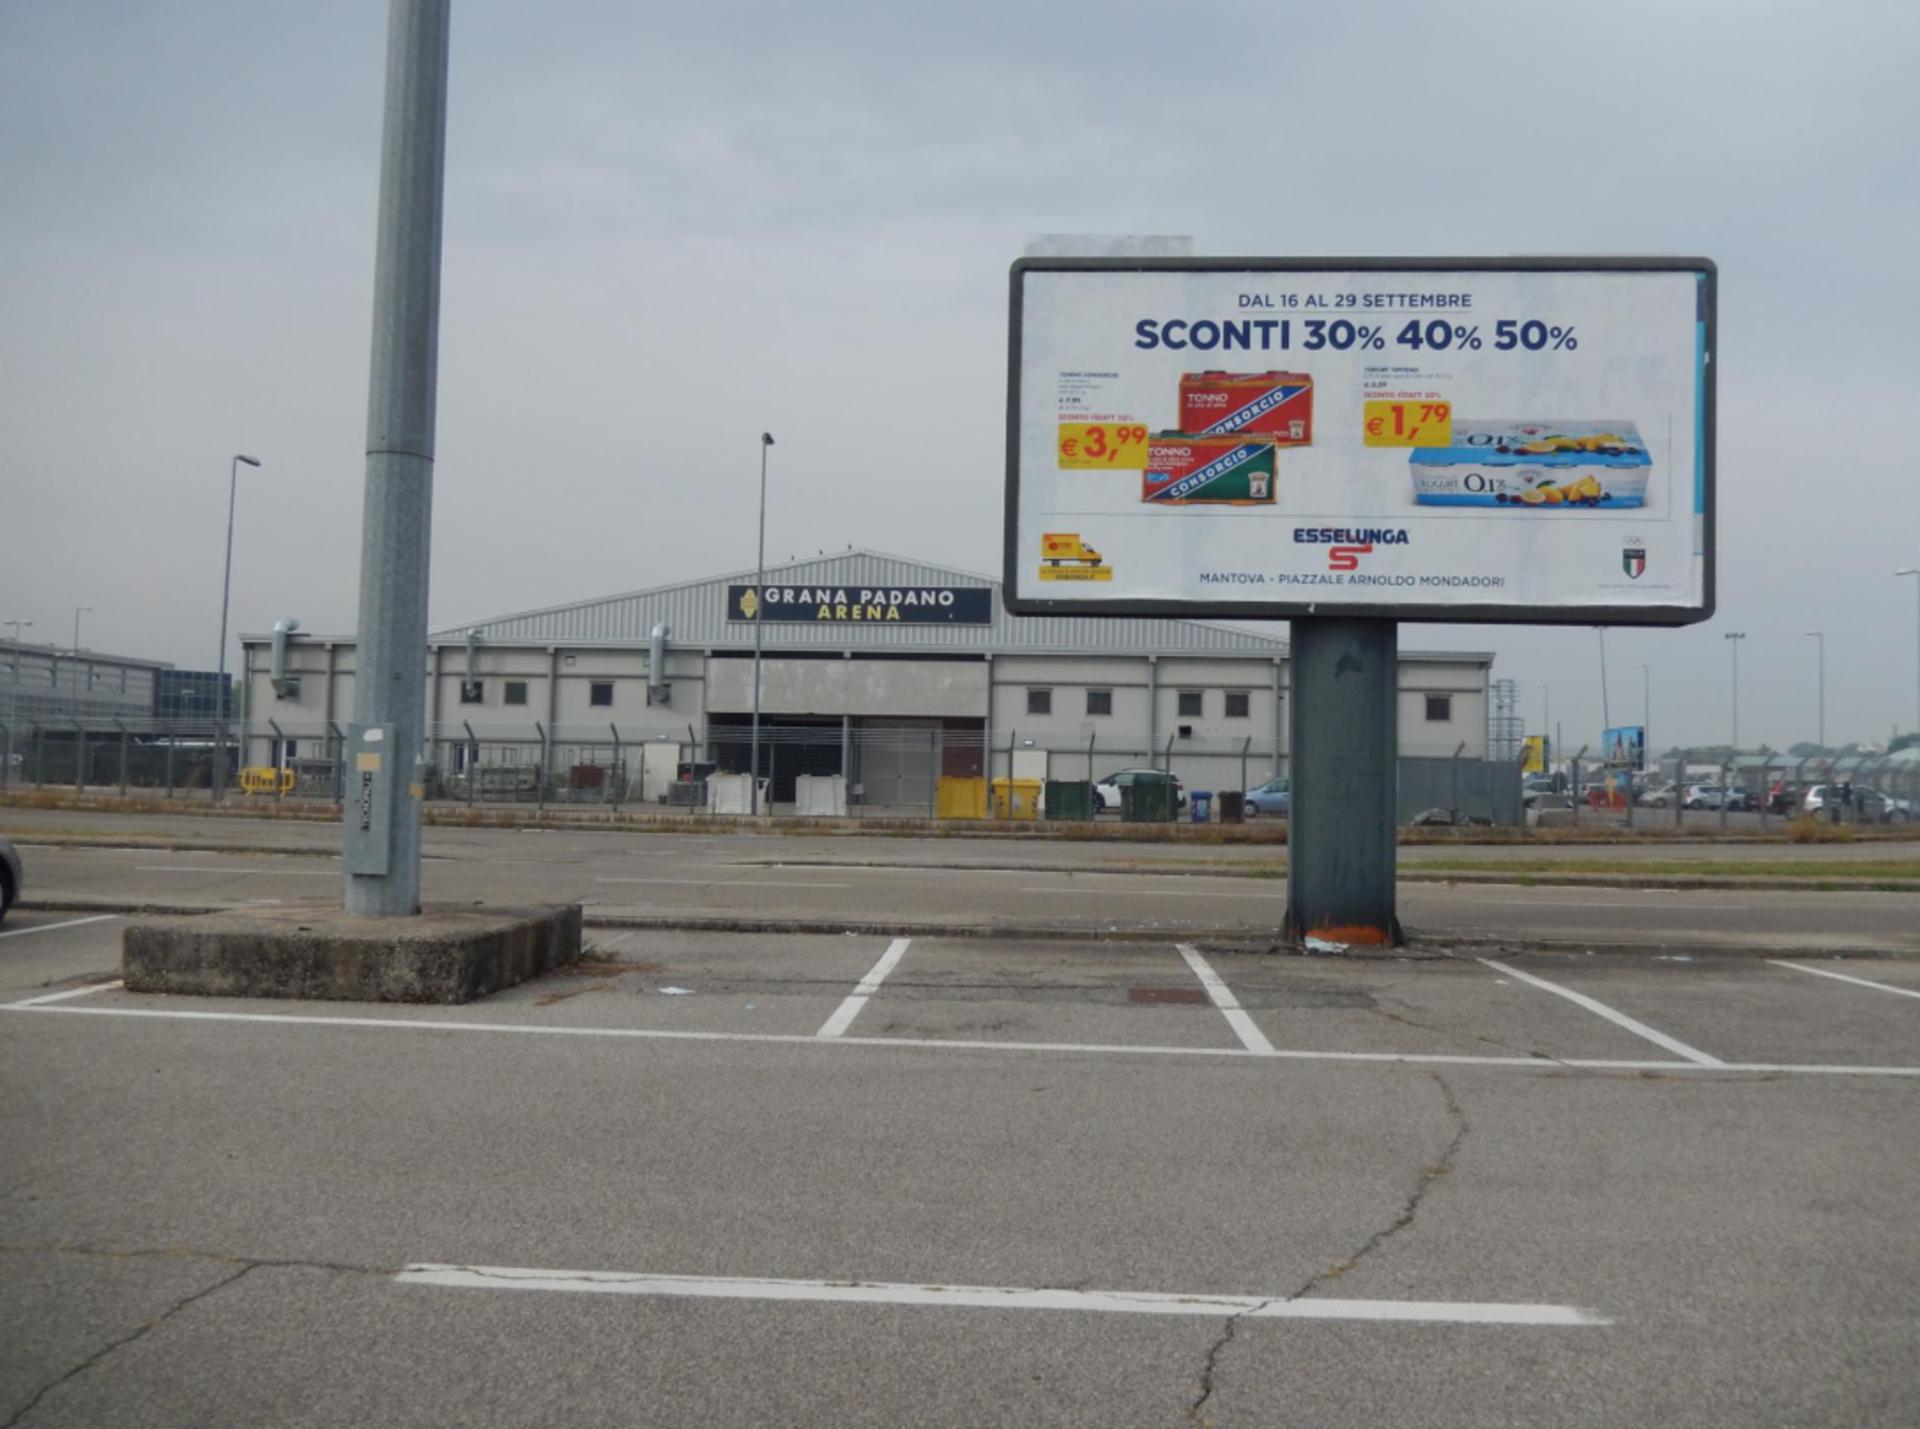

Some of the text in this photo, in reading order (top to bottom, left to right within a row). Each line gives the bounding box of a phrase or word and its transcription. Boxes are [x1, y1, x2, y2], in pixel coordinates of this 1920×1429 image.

[1238, 293, 1473, 308] DAL 16 AL 29 SETTEMBRE
[1134, 319, 1578, 351] SCONTI 30% 40% 50%
[1187, 393, 1229, 401] TONNO
[1208, 391, 1284, 434] ONSORCIO
[1366, 403, 1450, 441] € 1,79
[1060, 438, 1079, 458] €
[1083, 425, 1147, 464] 3,99
[1147, 447, 1192, 457] TONNO
[1169, 450, 1248, 497] CONSORCIO
[1293, 528, 1410, 545] ESSELUNGA
[1199, 573, 1266, 584] MANTOVA
[1278, 574, 1345, 585] PIAZZALE
[1348, 575, 1416, 586] ARNOLDO
[1419, 575, 1505, 587] MONDADORI
[764, 588, 955, 606] GRANA PADANO
[816, 604, 900, 620] ARENA
